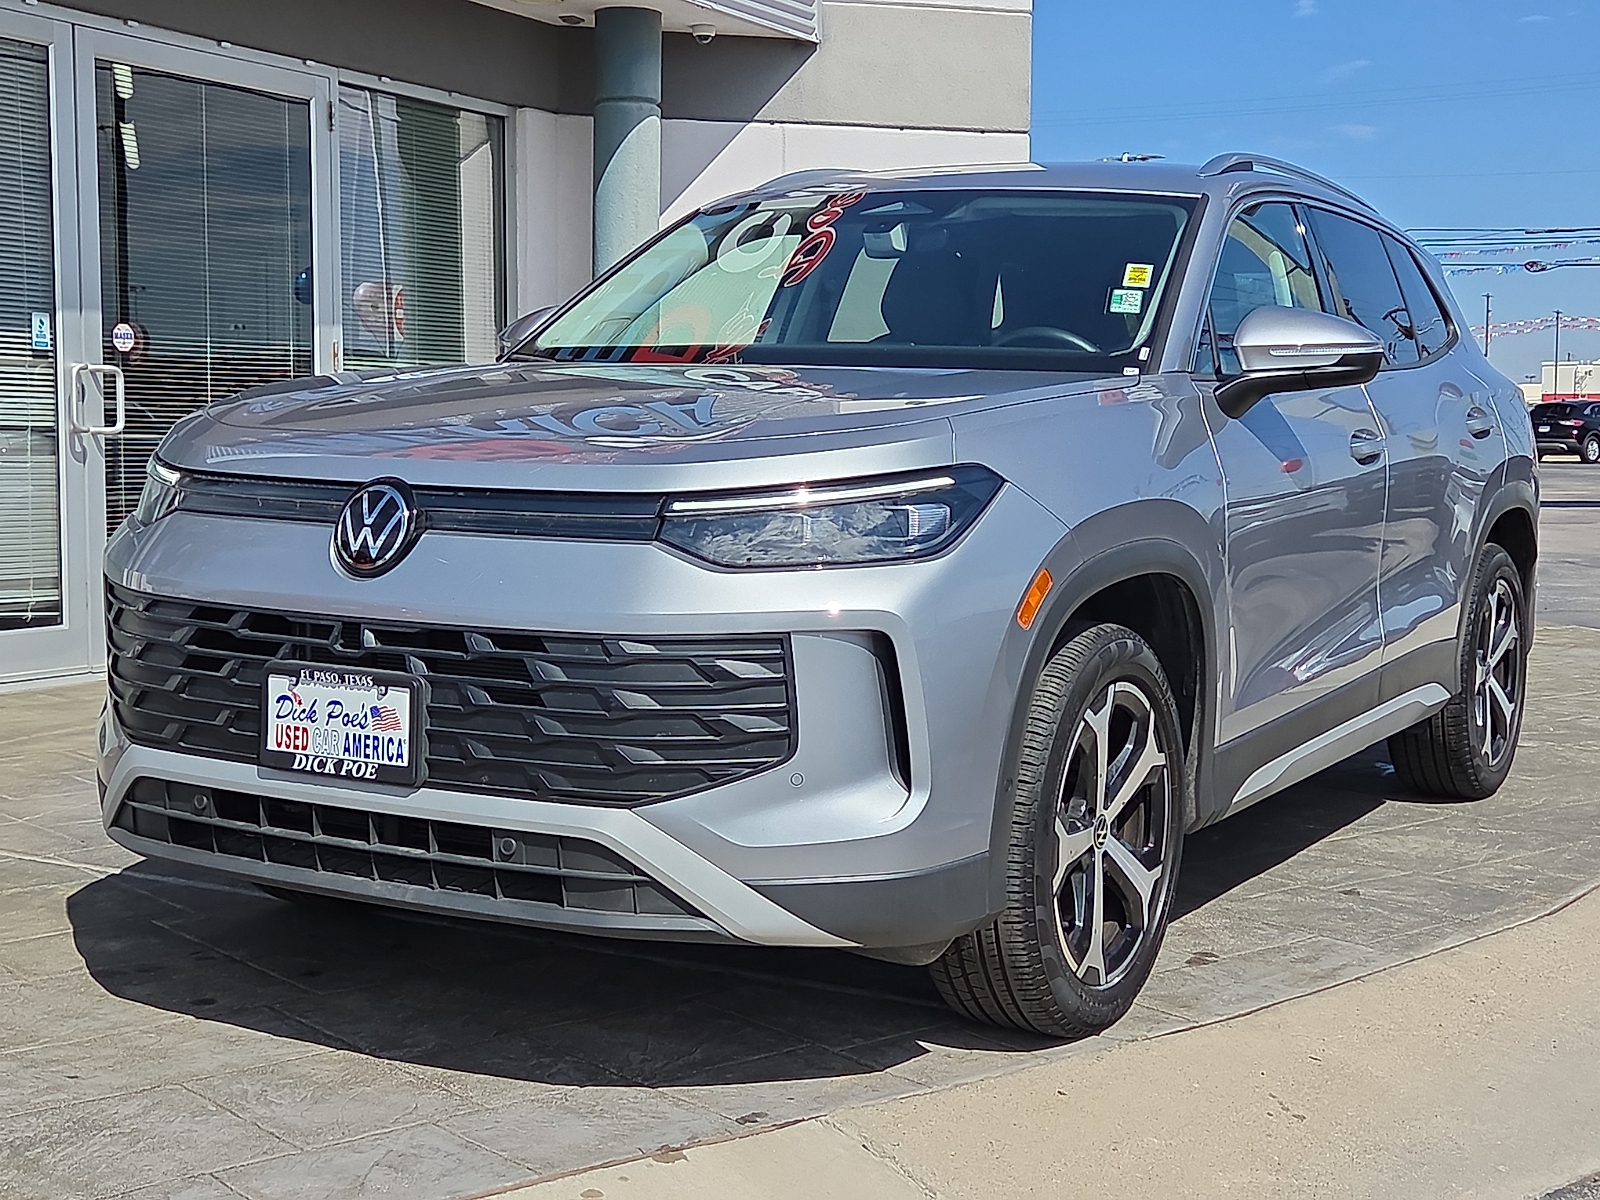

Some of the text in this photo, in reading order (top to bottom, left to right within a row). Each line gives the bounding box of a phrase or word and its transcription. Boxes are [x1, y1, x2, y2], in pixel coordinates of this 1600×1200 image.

[342, 486, 405, 563] VW
[300, 669, 374, 687] EL PASO, TEXAS
[276, 694, 370, 731] Dick Poe's
[275, 723, 404, 764] USED CAR AMERICA
[292, 753, 379, 780] DICK POE
